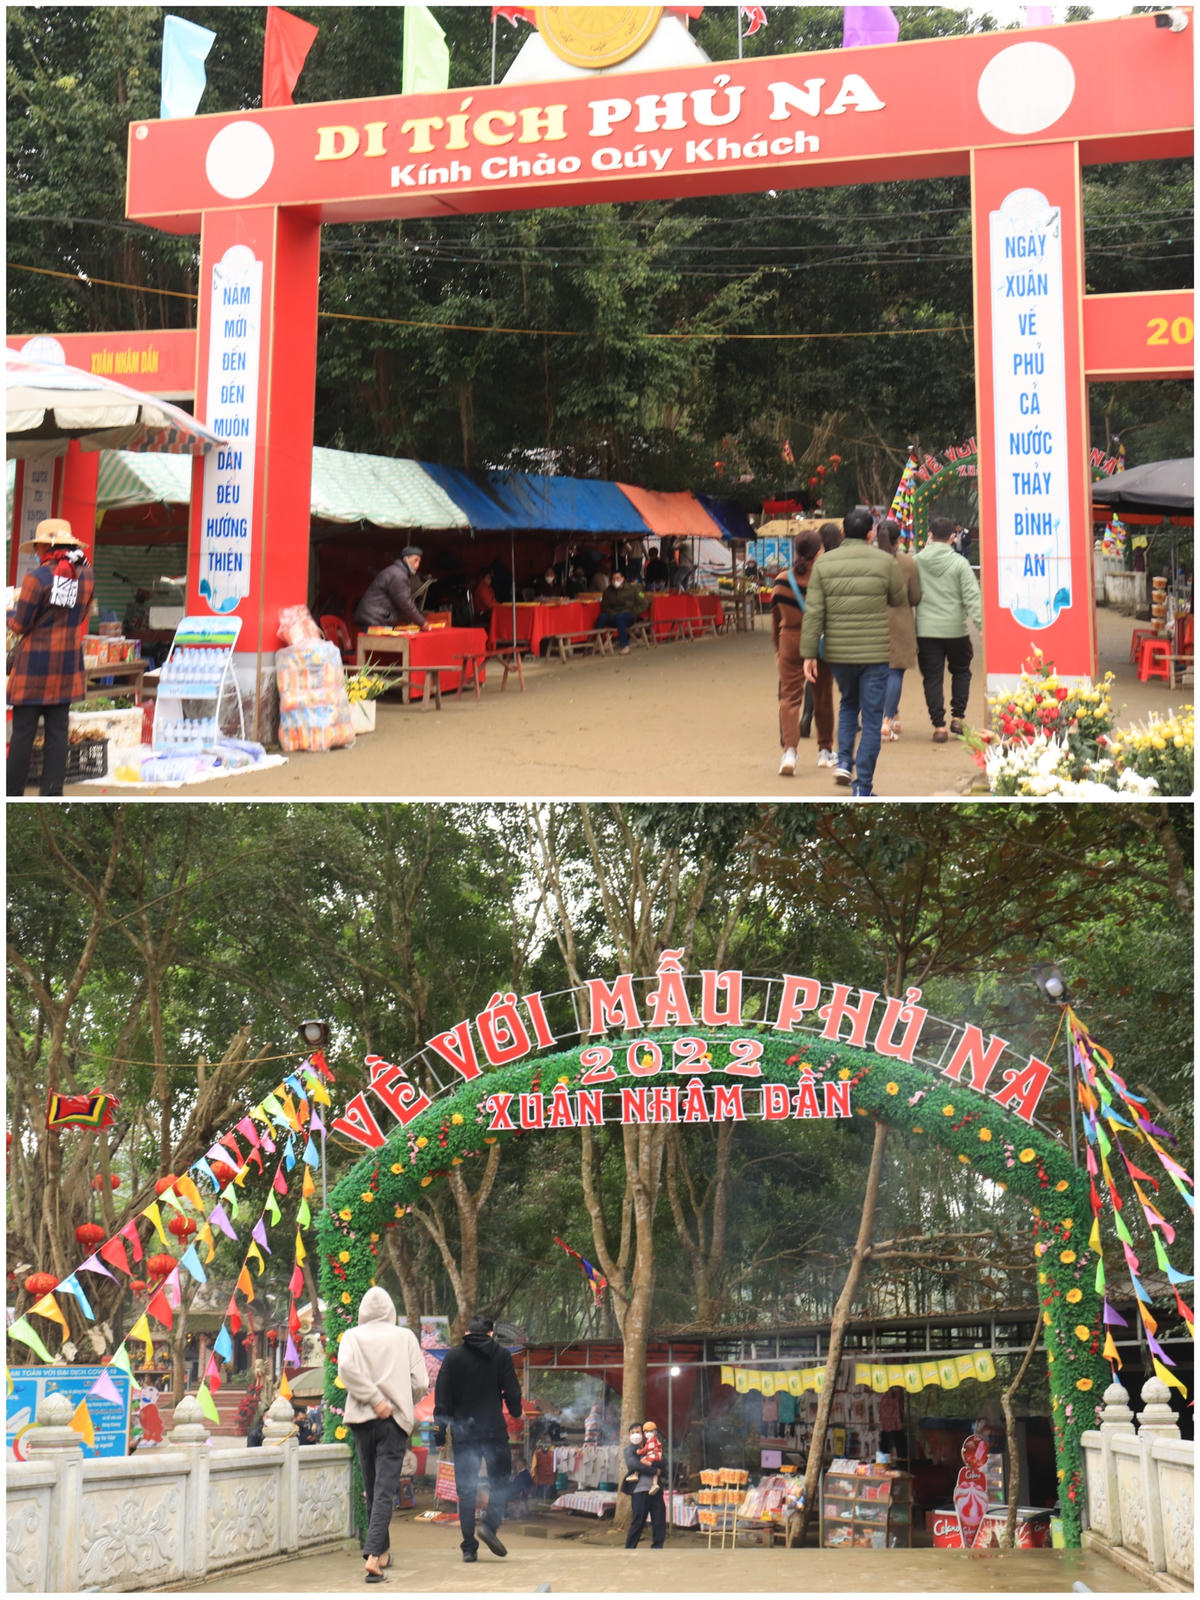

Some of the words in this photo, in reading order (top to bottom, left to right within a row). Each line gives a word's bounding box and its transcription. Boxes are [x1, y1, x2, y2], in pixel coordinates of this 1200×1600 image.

[314, 121, 388, 162] DI
[401, 96, 568, 154] TÍCH
[588, 74, 746, 137] PHỦ
[768, 74, 886, 121] NA
[390, 160, 471, 187] Kính
[481, 152, 581, 180] Chào
[591, 144, 673, 171] Qúy
[686, 130, 820, 163] Khách
[1006, 268, 1048, 298] XUÂN
[224, 313, 248, 339] MỚI
[1018, 305, 1037, 336] VỀ
[1013, 342, 1045, 376] PHỦ
[1019, 381, 1041, 415] CẢ
[1009, 424, 1053, 456] NƯỚC
[1012, 461, 1052, 496] THẢY
[206, 512, 248, 538] HƯỚNG
[1014, 507, 1053, 536] BÌNH
[208, 547, 243, 577] THIỆN
[1023, 553, 1046, 577] AN
[330, 1054, 432, 1150] VỀ
[426, 991, 558, 1082] VỚI
[585, 948, 744, 1036] MẪU
[772, 974, 928, 1064] PHỦ
[939, 1022, 1053, 1126] NA
[579, 1037, 764, 1085] 2022
[486, 1082, 606, 1131] XUÂN
[619, 1077, 747, 1125] NHÂM
[761, 1067, 853, 1121] DẦN
